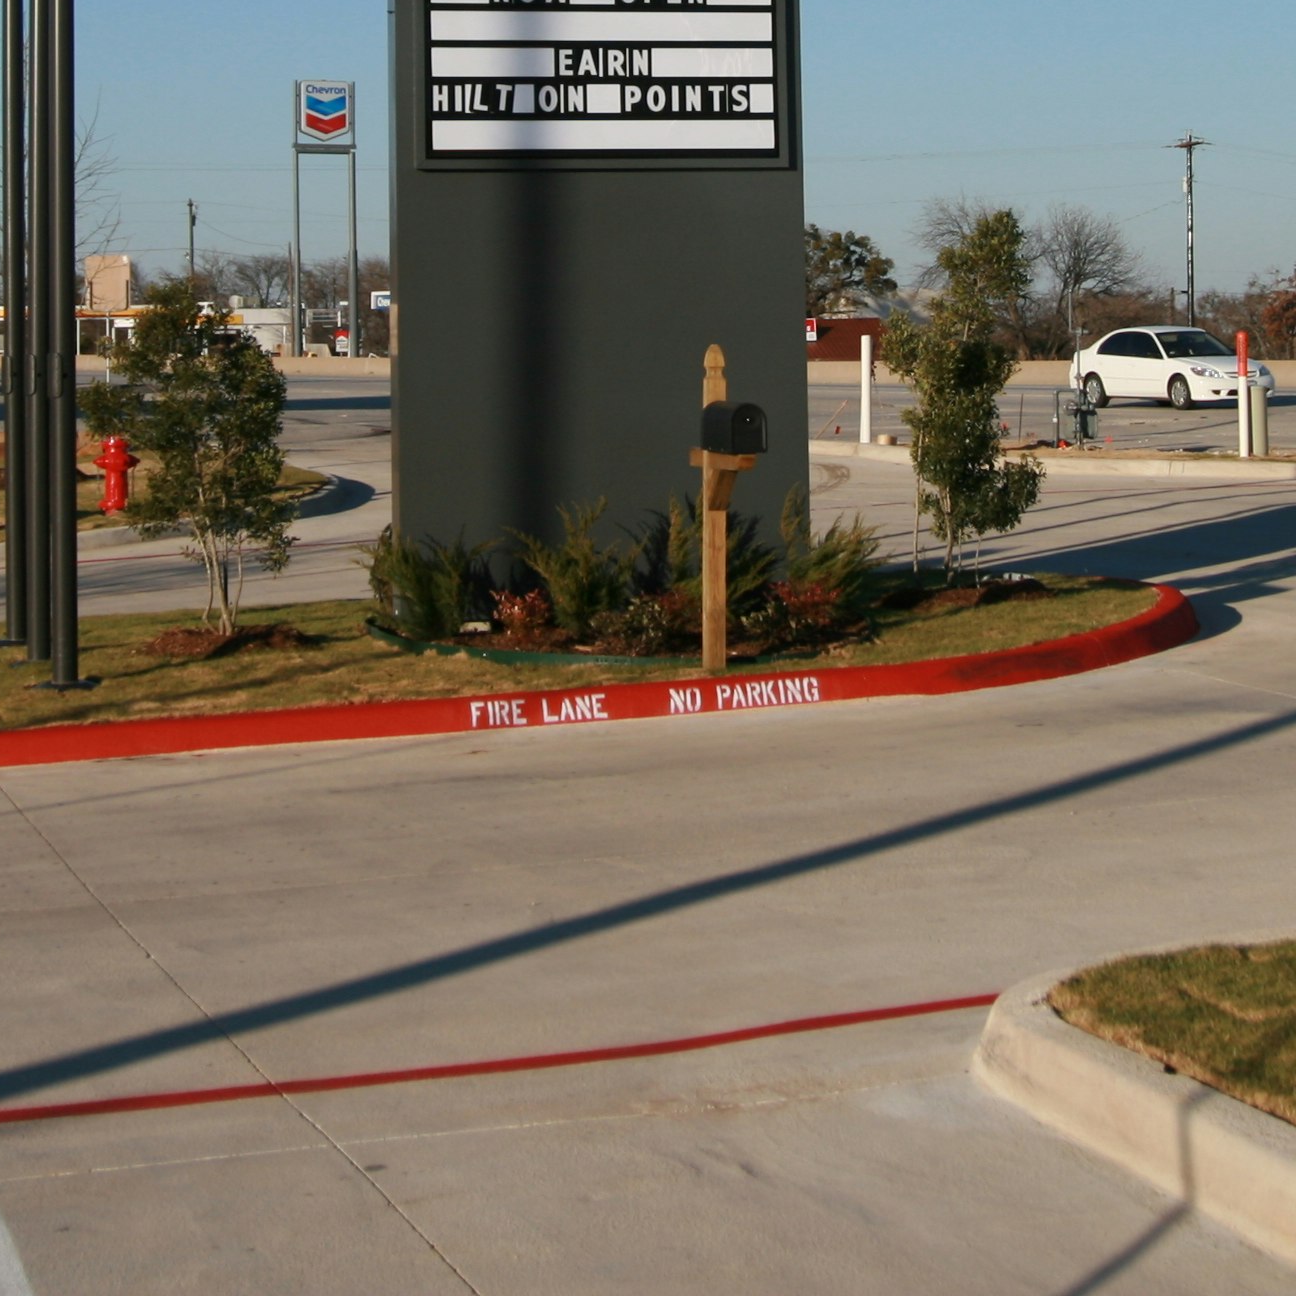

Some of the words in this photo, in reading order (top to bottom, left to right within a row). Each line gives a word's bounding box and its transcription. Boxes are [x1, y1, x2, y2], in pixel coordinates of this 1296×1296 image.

[559, 49, 649, 76] EARN
[306, 85, 346, 94] Chevron
[624, 85, 749, 112] POINTS
[470, 699, 527, 727] FIRE
[542, 694, 608, 723] LANE
[669, 688, 702, 714] NO
[716, 677, 819, 709] PARKING
